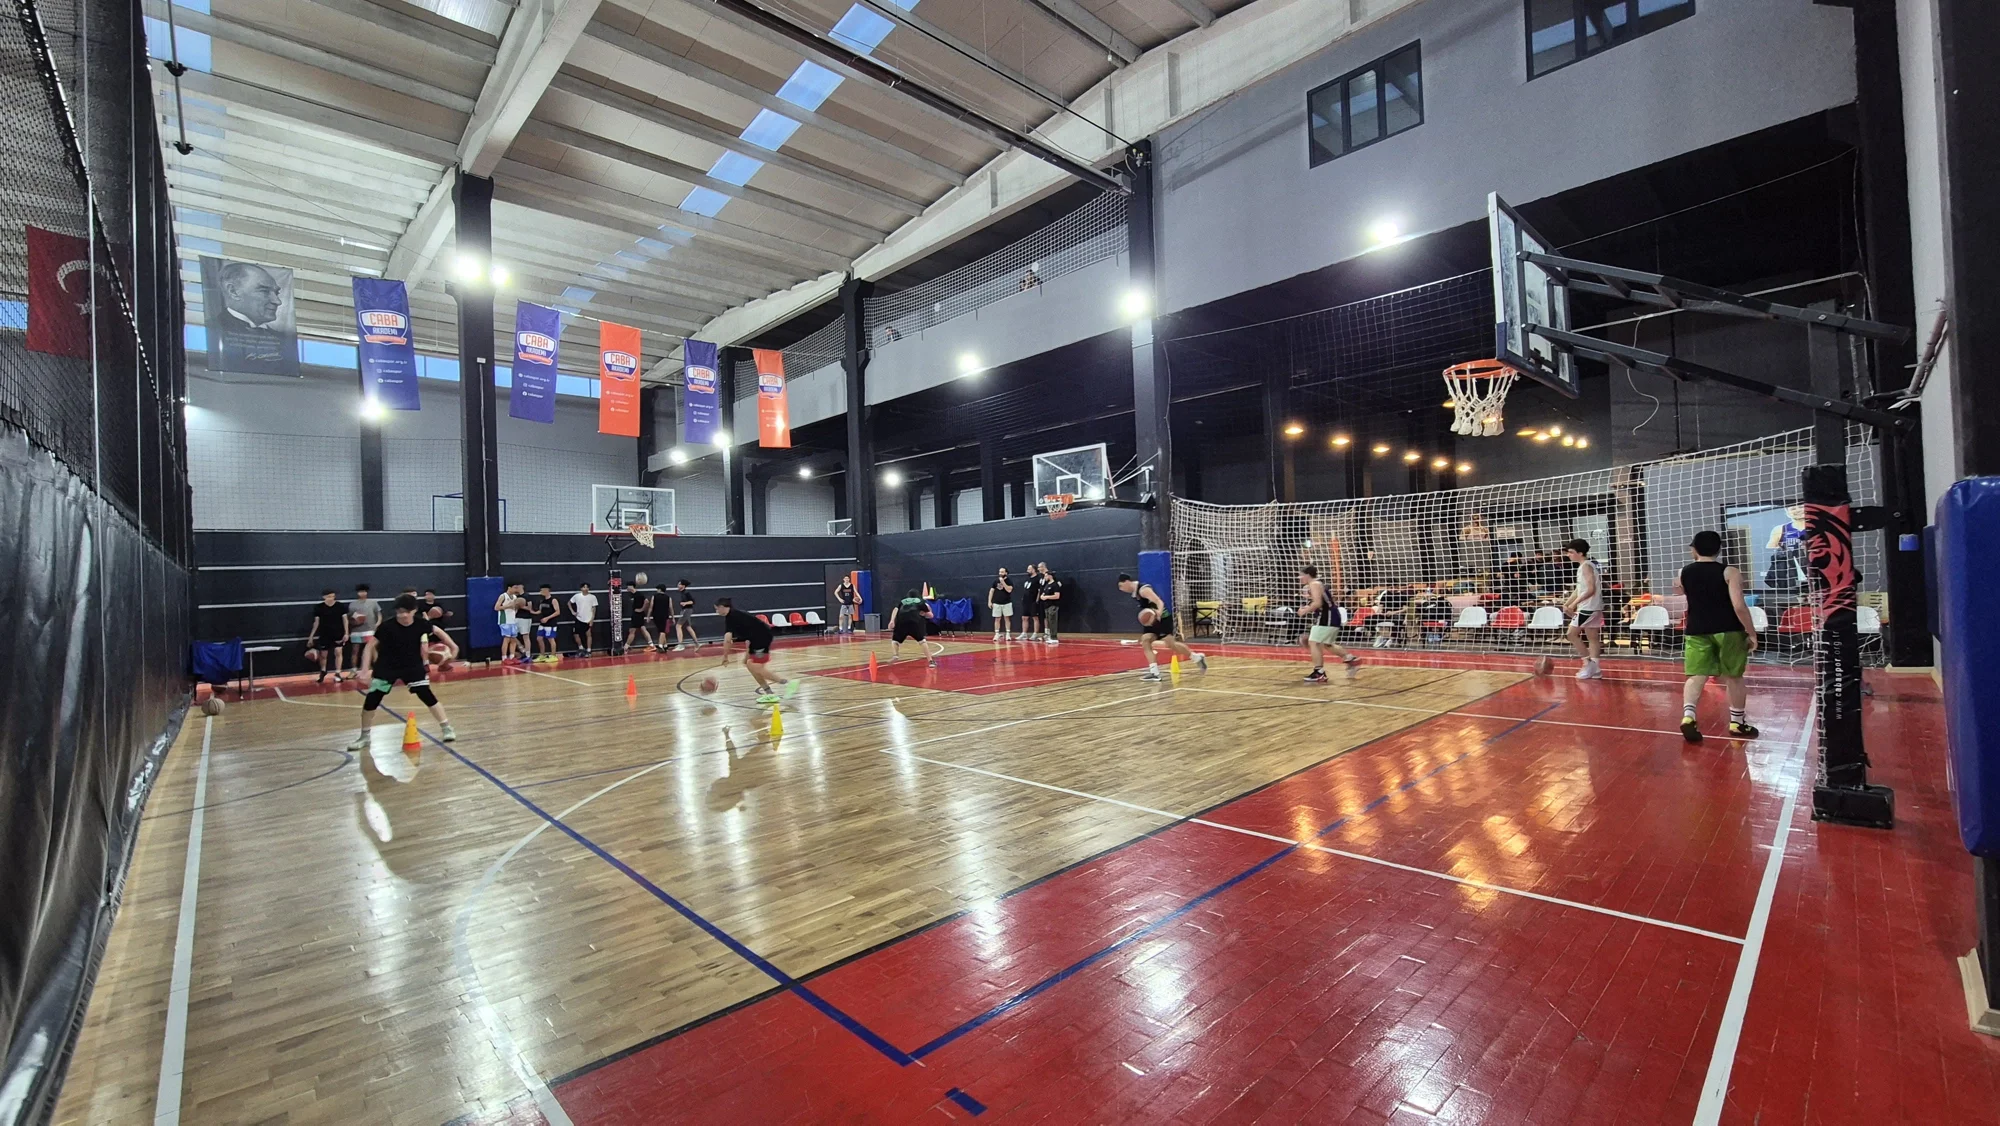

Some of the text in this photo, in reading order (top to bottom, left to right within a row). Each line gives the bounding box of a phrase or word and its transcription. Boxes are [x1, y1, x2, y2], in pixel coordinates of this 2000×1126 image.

[369, 313, 399, 327] CABA
[525, 334, 549, 349] CABA
[610, 353, 631, 366] CABA
